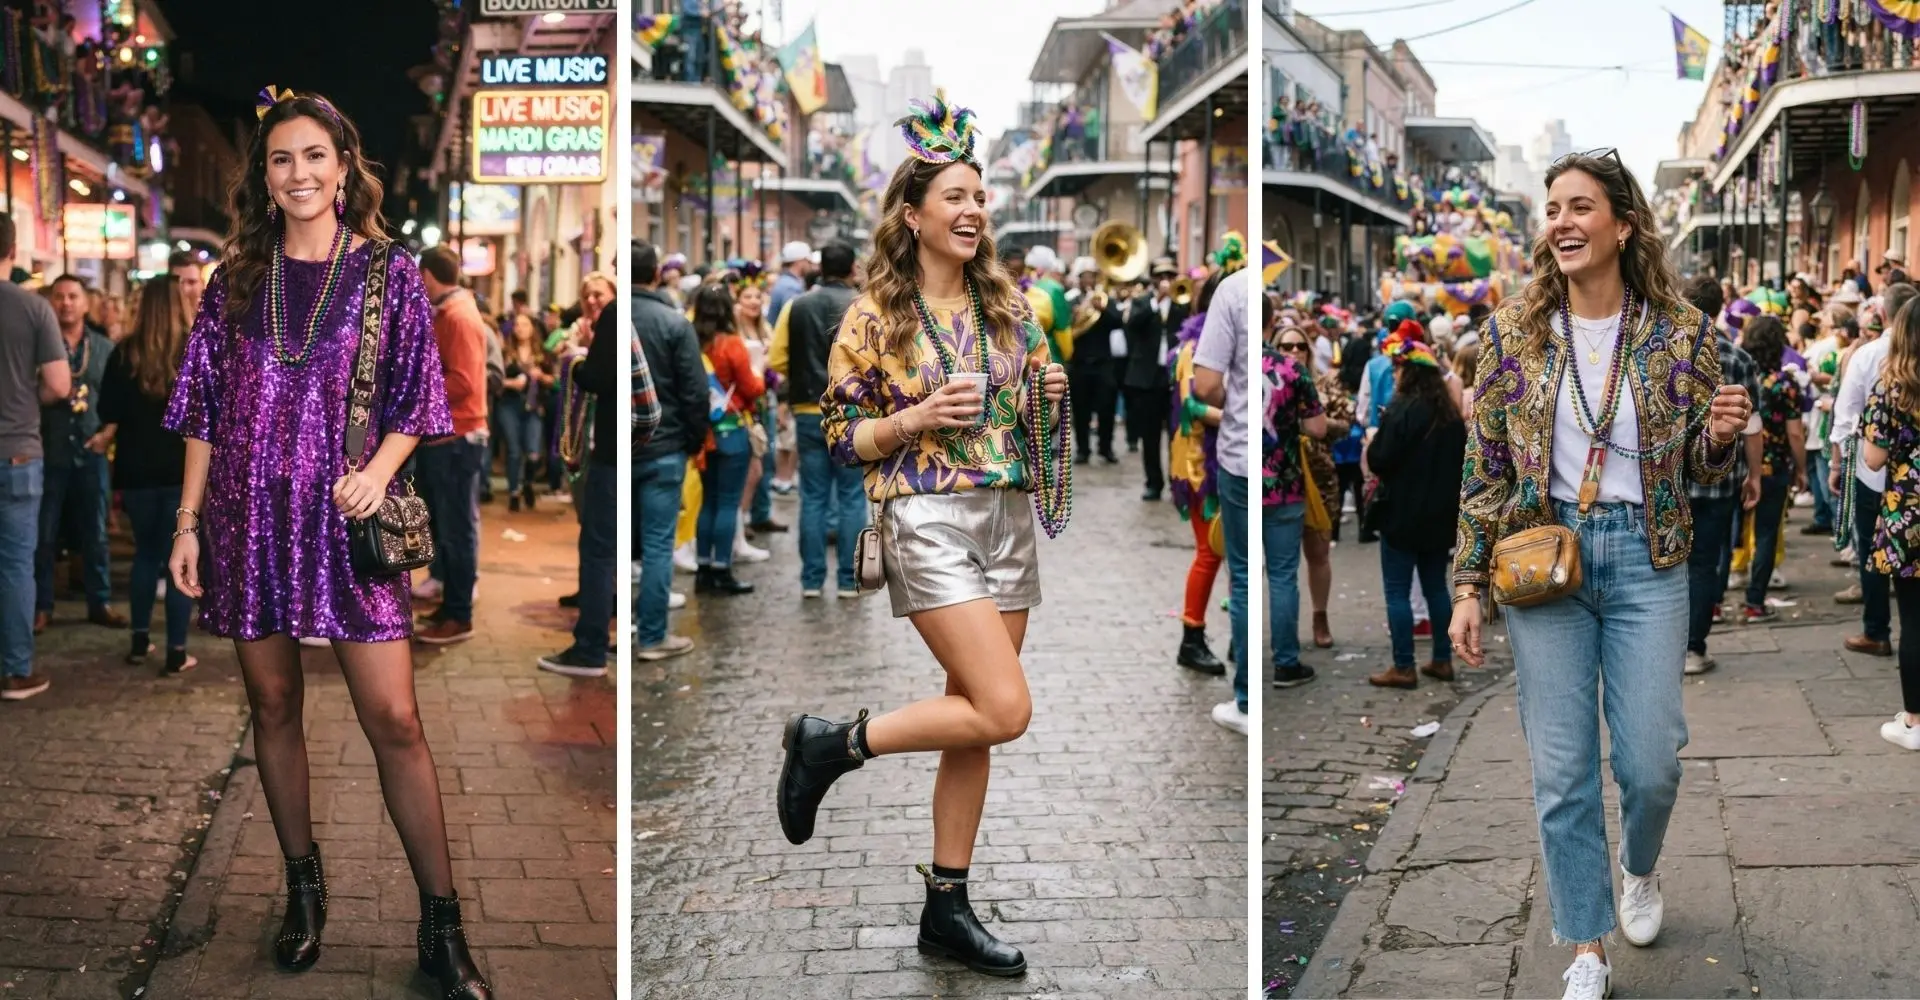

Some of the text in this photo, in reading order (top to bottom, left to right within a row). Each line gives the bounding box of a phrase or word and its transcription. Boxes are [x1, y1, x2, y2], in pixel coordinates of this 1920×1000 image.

[482, 56, 606, 83] LIVE MUSIC
[481, 95, 602, 122] LIVE MUSIC
[479, 125, 604, 152] MARDI GRAS
[944, 429, 1022, 466] NOLA
